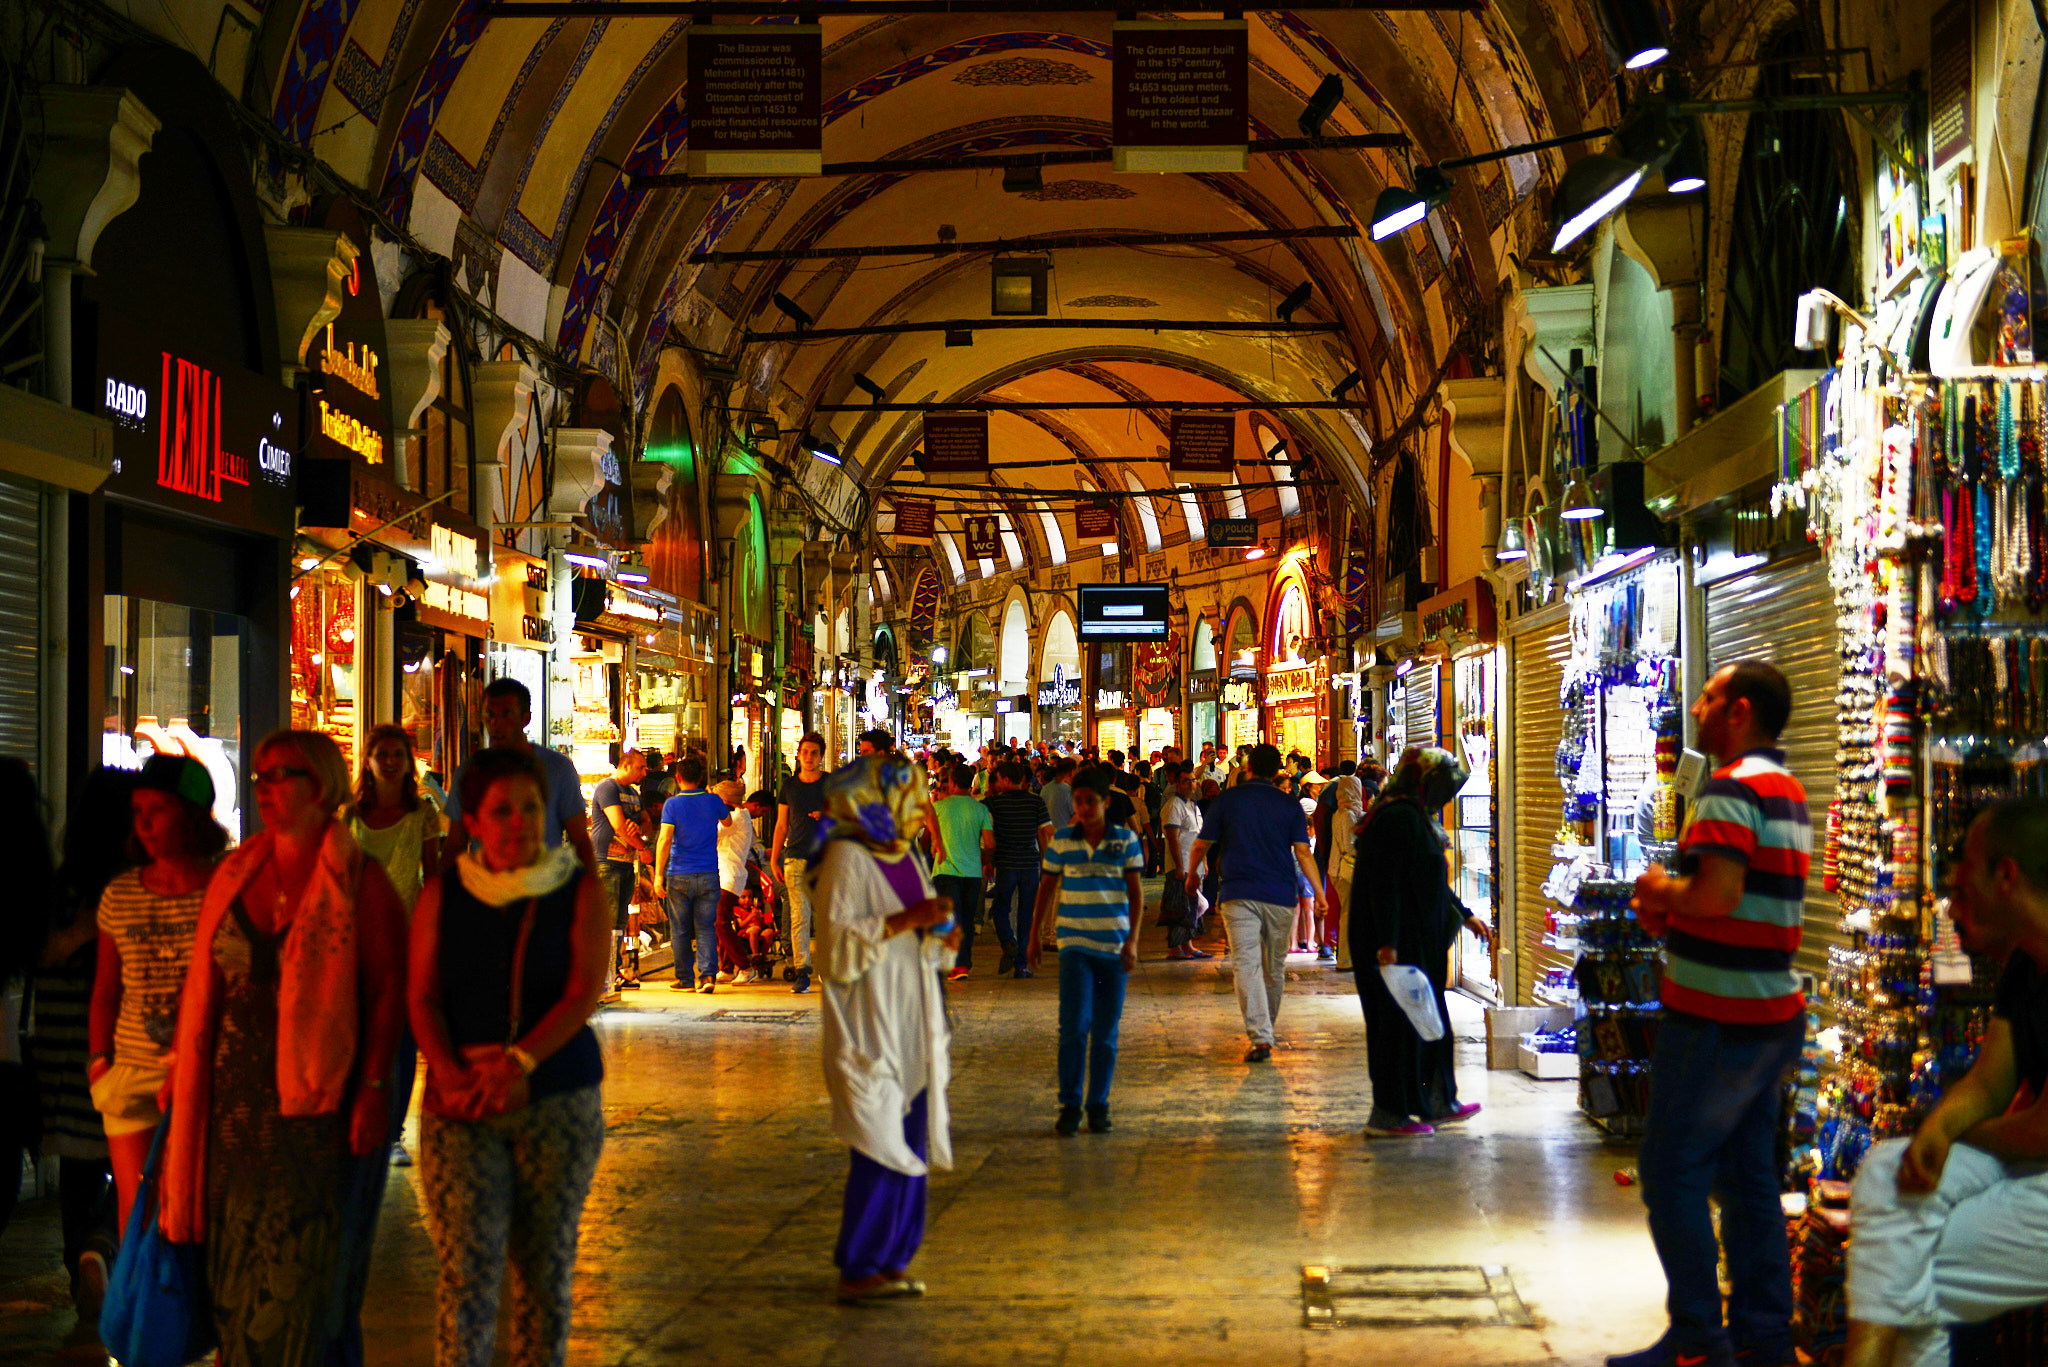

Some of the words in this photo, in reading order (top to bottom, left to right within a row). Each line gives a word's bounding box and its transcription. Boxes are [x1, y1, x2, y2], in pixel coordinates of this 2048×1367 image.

[718, 44, 735, 53] The
[738, 44, 769, 53] Bazaar
[1127, 46, 1144, 55] The
[1147, 46, 1175, 55] Grand
[1179, 46, 1211, 55] Bazaar
[1214, 46, 1234, 55] built
[713, 56, 781, 65] commissioned
[784, 56, 795, 66] by
[1137, 58, 1145, 67] in
[1149, 58, 1163, 67] the
[1185, 59, 1223, 69] century,
[704, 68, 741, 77] Mehmet
[752, 68, 805, 79] (1444-1481)
[1135, 71, 1176, 81] covering
[1216, 70, 1225, 79] of
[706, 81, 761, 91] immediately
[765, 81, 786, 90] after
[789, 81, 803, 90] the
[1129, 83, 1159, 93] 54,653
[1162, 85, 1194, 93] square
[706, 93, 745, 102] Ottoman
[748, 94, 791, 103] conquest
[795, 93, 804, 102] of
[1142, 96, 1149, 104] is
[1153, 95, 1167, 104] the
[1170, 95, 1198, 104] oldest
[1202, 95, 1219, 104] and
[712, 105, 749, 114] Istanbul
[752, 105, 760, 114] in
[764, 105, 785, 114] 1453
[788, 106, 797, 114] to
[1127, 108, 1159, 119] largest
[1162, 108, 1199, 117] covered
[1203, 108, 1233, 117] bazaar
[692, 118, 726, 128] provide
[730, 118, 768, 126] financial
[1151, 120, 1159, 128] in
[1163, 120, 1177, 128] the
[1180, 120, 1209, 128] world.
[715, 130, 727, 139] for
[730, 130, 757, 141] Hagia
[760, 130, 794, 140] Sophia.
[105, 377, 147, 420] RADO
[259, 436, 291, 477] CIMIER
[1225, 523, 1255, 534] POLICE
[972, 541, 995, 550] WC
